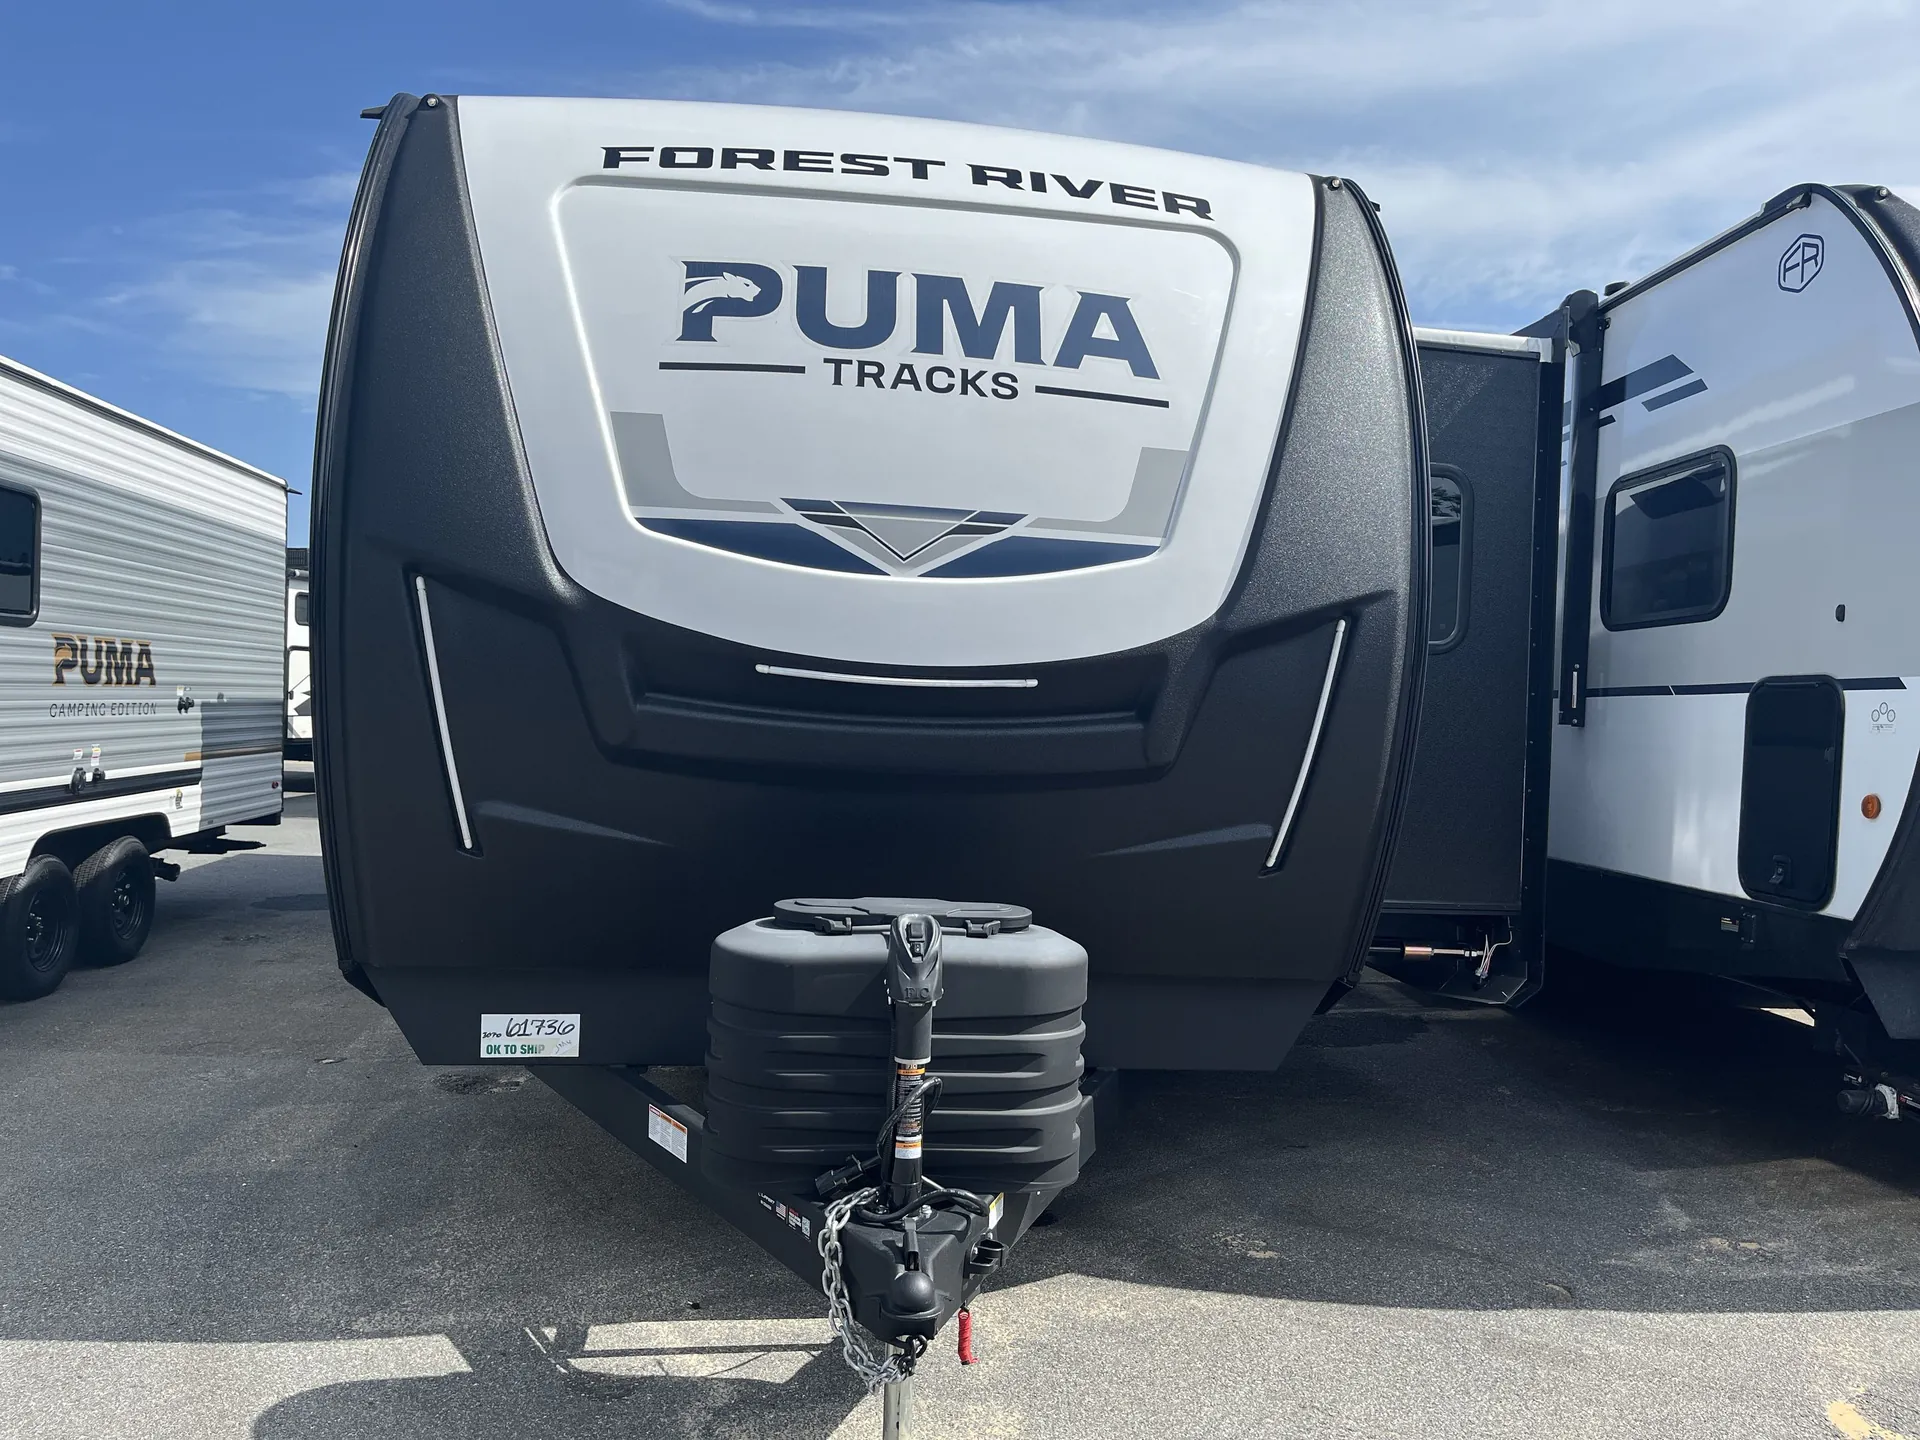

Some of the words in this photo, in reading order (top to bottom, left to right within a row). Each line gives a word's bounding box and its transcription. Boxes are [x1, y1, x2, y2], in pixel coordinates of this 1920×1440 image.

[601, 145, 946, 180] FOREST
[968, 163, 1215, 222] RIVER
[676, 260, 1161, 380] PUMA
[823, 356, 1020, 401] TRACKS
[51, 633, 157, 687] PUMA
[49, 702, 106, 718] CAMPING
[110, 701, 157, 717] EDITION
[486, 1044, 502, 1055] OK
[504, 1044, 517, 1055] TO
[505, 1017, 576, 1038] 61736
